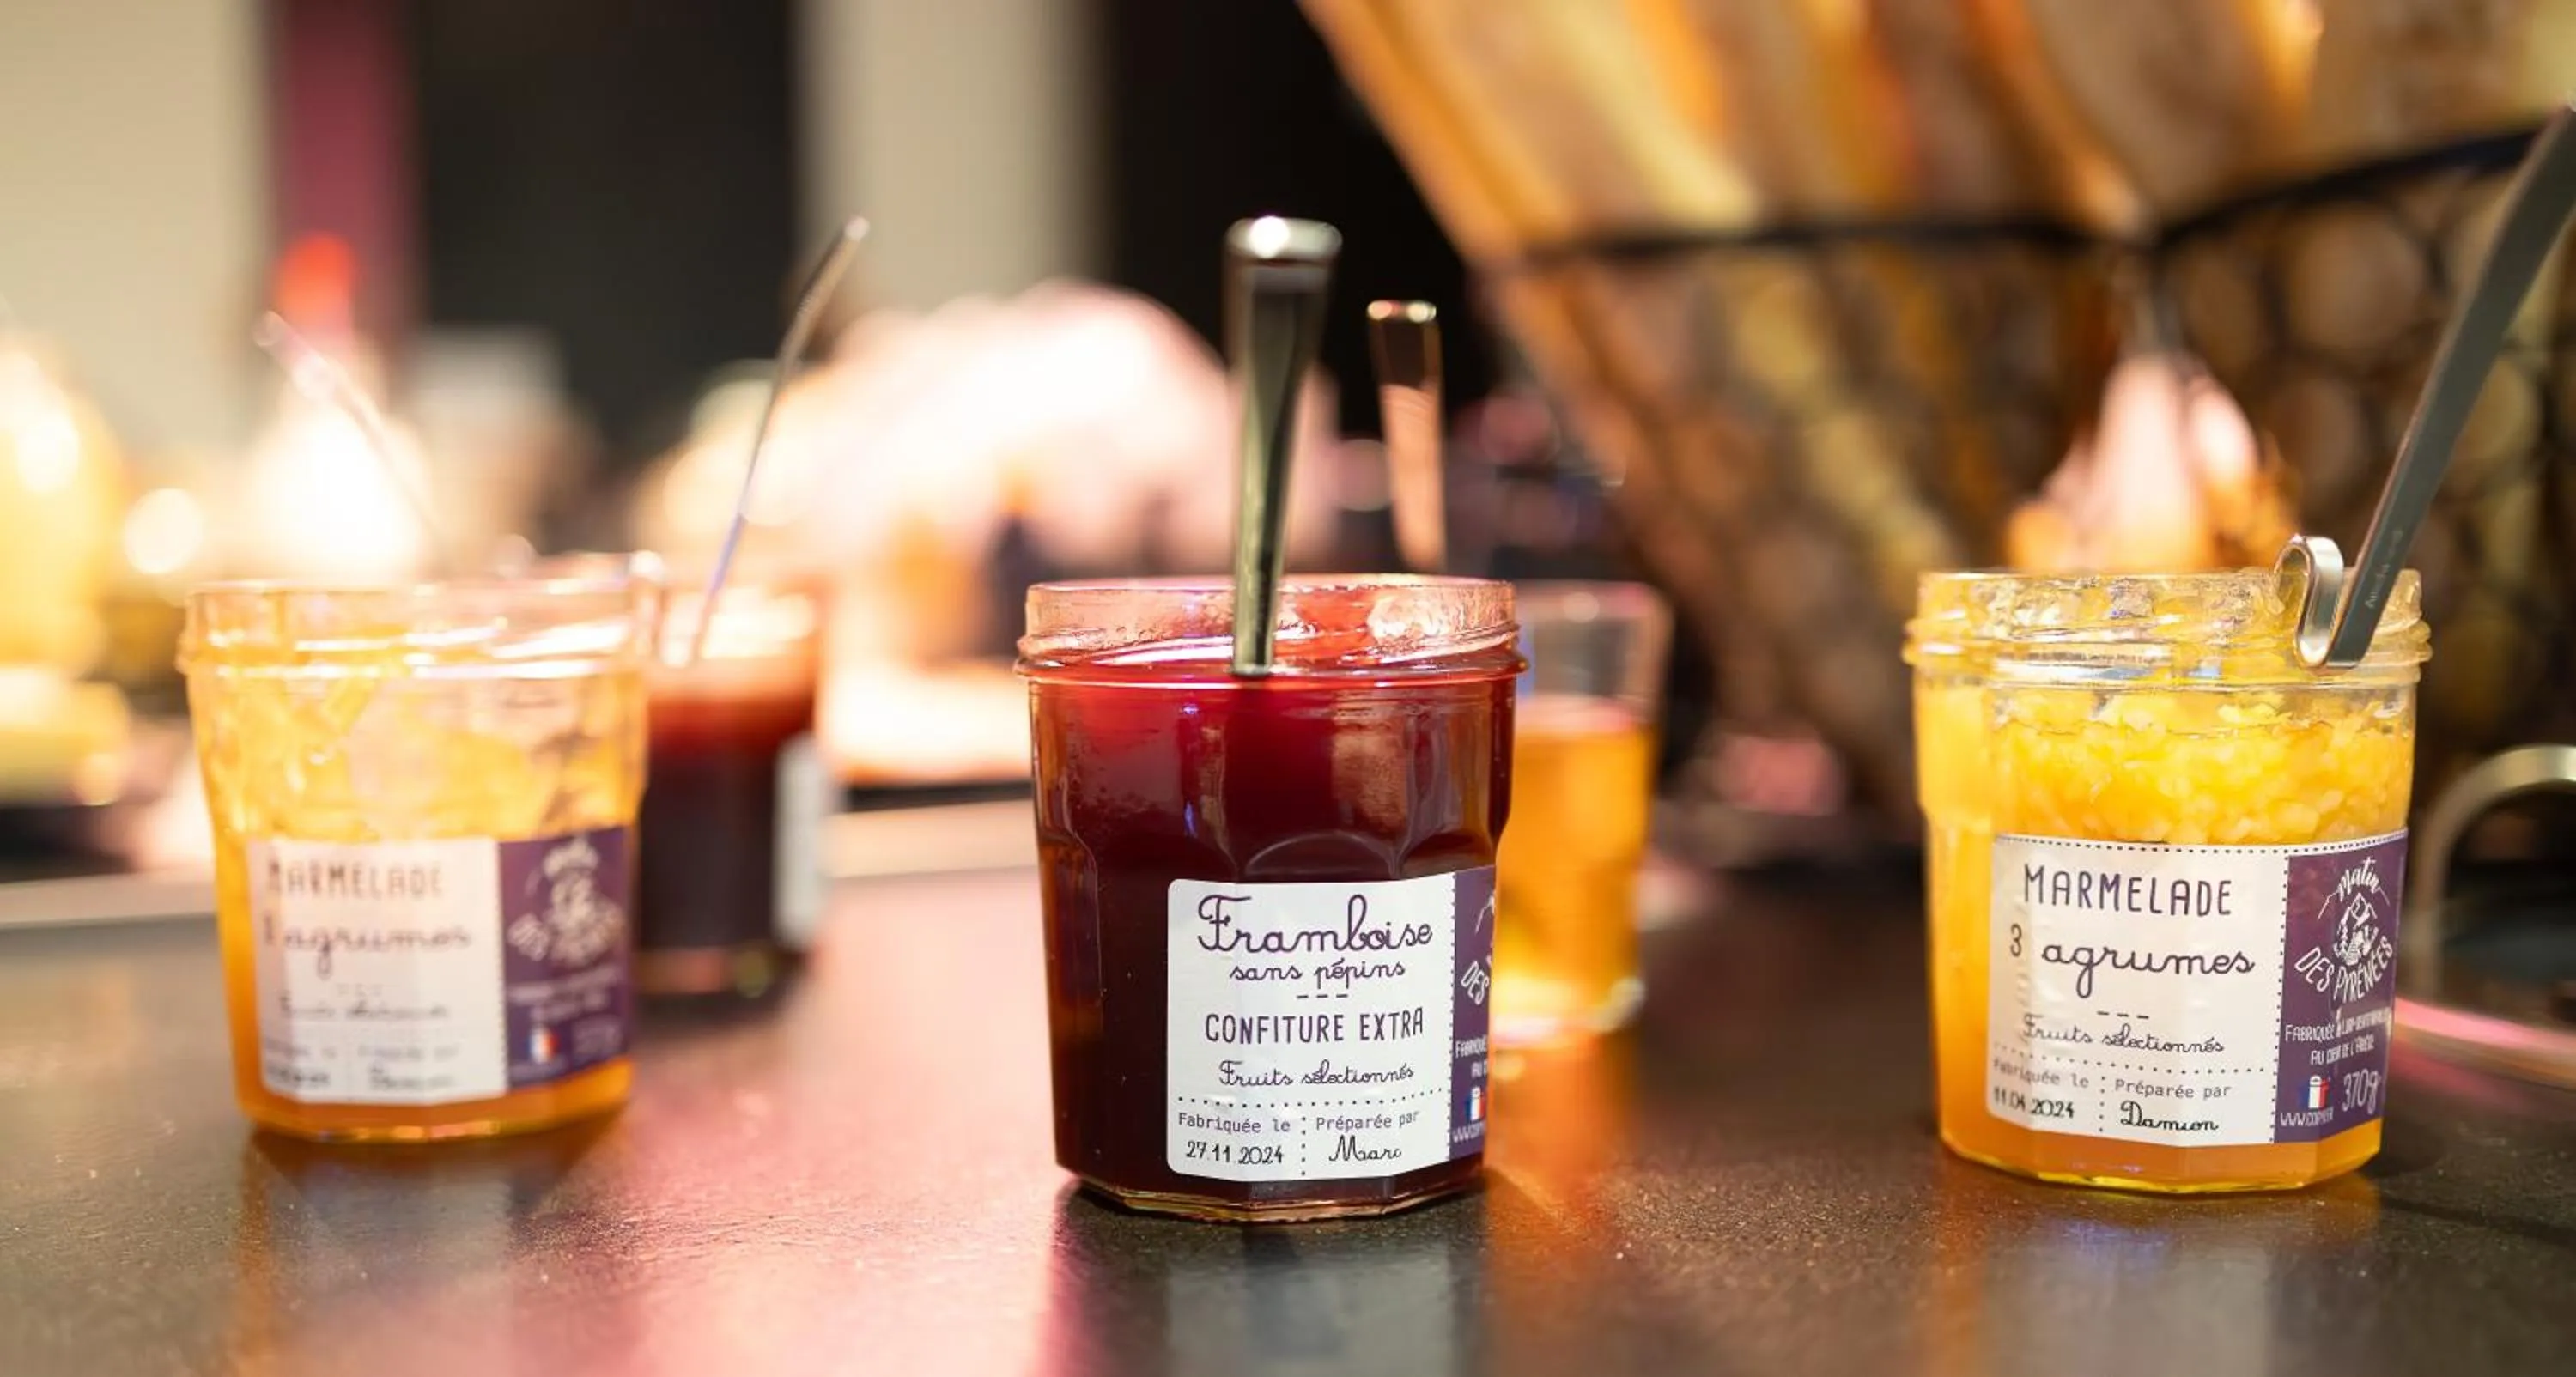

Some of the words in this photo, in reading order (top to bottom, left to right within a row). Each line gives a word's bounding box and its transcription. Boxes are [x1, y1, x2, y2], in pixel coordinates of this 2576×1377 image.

[2024, 864, 2232, 916] MARMELADE
[1198, 894, 1433, 953] Framboise
[1230, 965, 1303, 981] sans
[1314, 957, 1406, 989] pépins
[2010, 923, 2023, 957] 3
[2042, 944, 2256, 998] agrumes
[2294, 946, 2335, 992] DES
[1205, 1014, 1345, 1044] CONFITURE
[1359, 1006, 1424, 1041] EXTRA
[2022, 1013, 2093, 1043] Fruits
[2101, 1023, 2226, 1053] sélectionnés
[1219, 1060, 1293, 1087] Fruits
[1301, 1059, 1415, 1085] sélectionnés
[2071, 1072, 2089, 1088] le
[2115, 1078, 2195, 1099] Préparée
[2203, 1085, 2233, 1101] par
[1179, 1112, 1261, 1134] Fabriquée
[1273, 1118, 1291, 1132] le
[1316, 1114, 1392, 1132] Préparée
[1399, 1110, 1420, 1129] par
